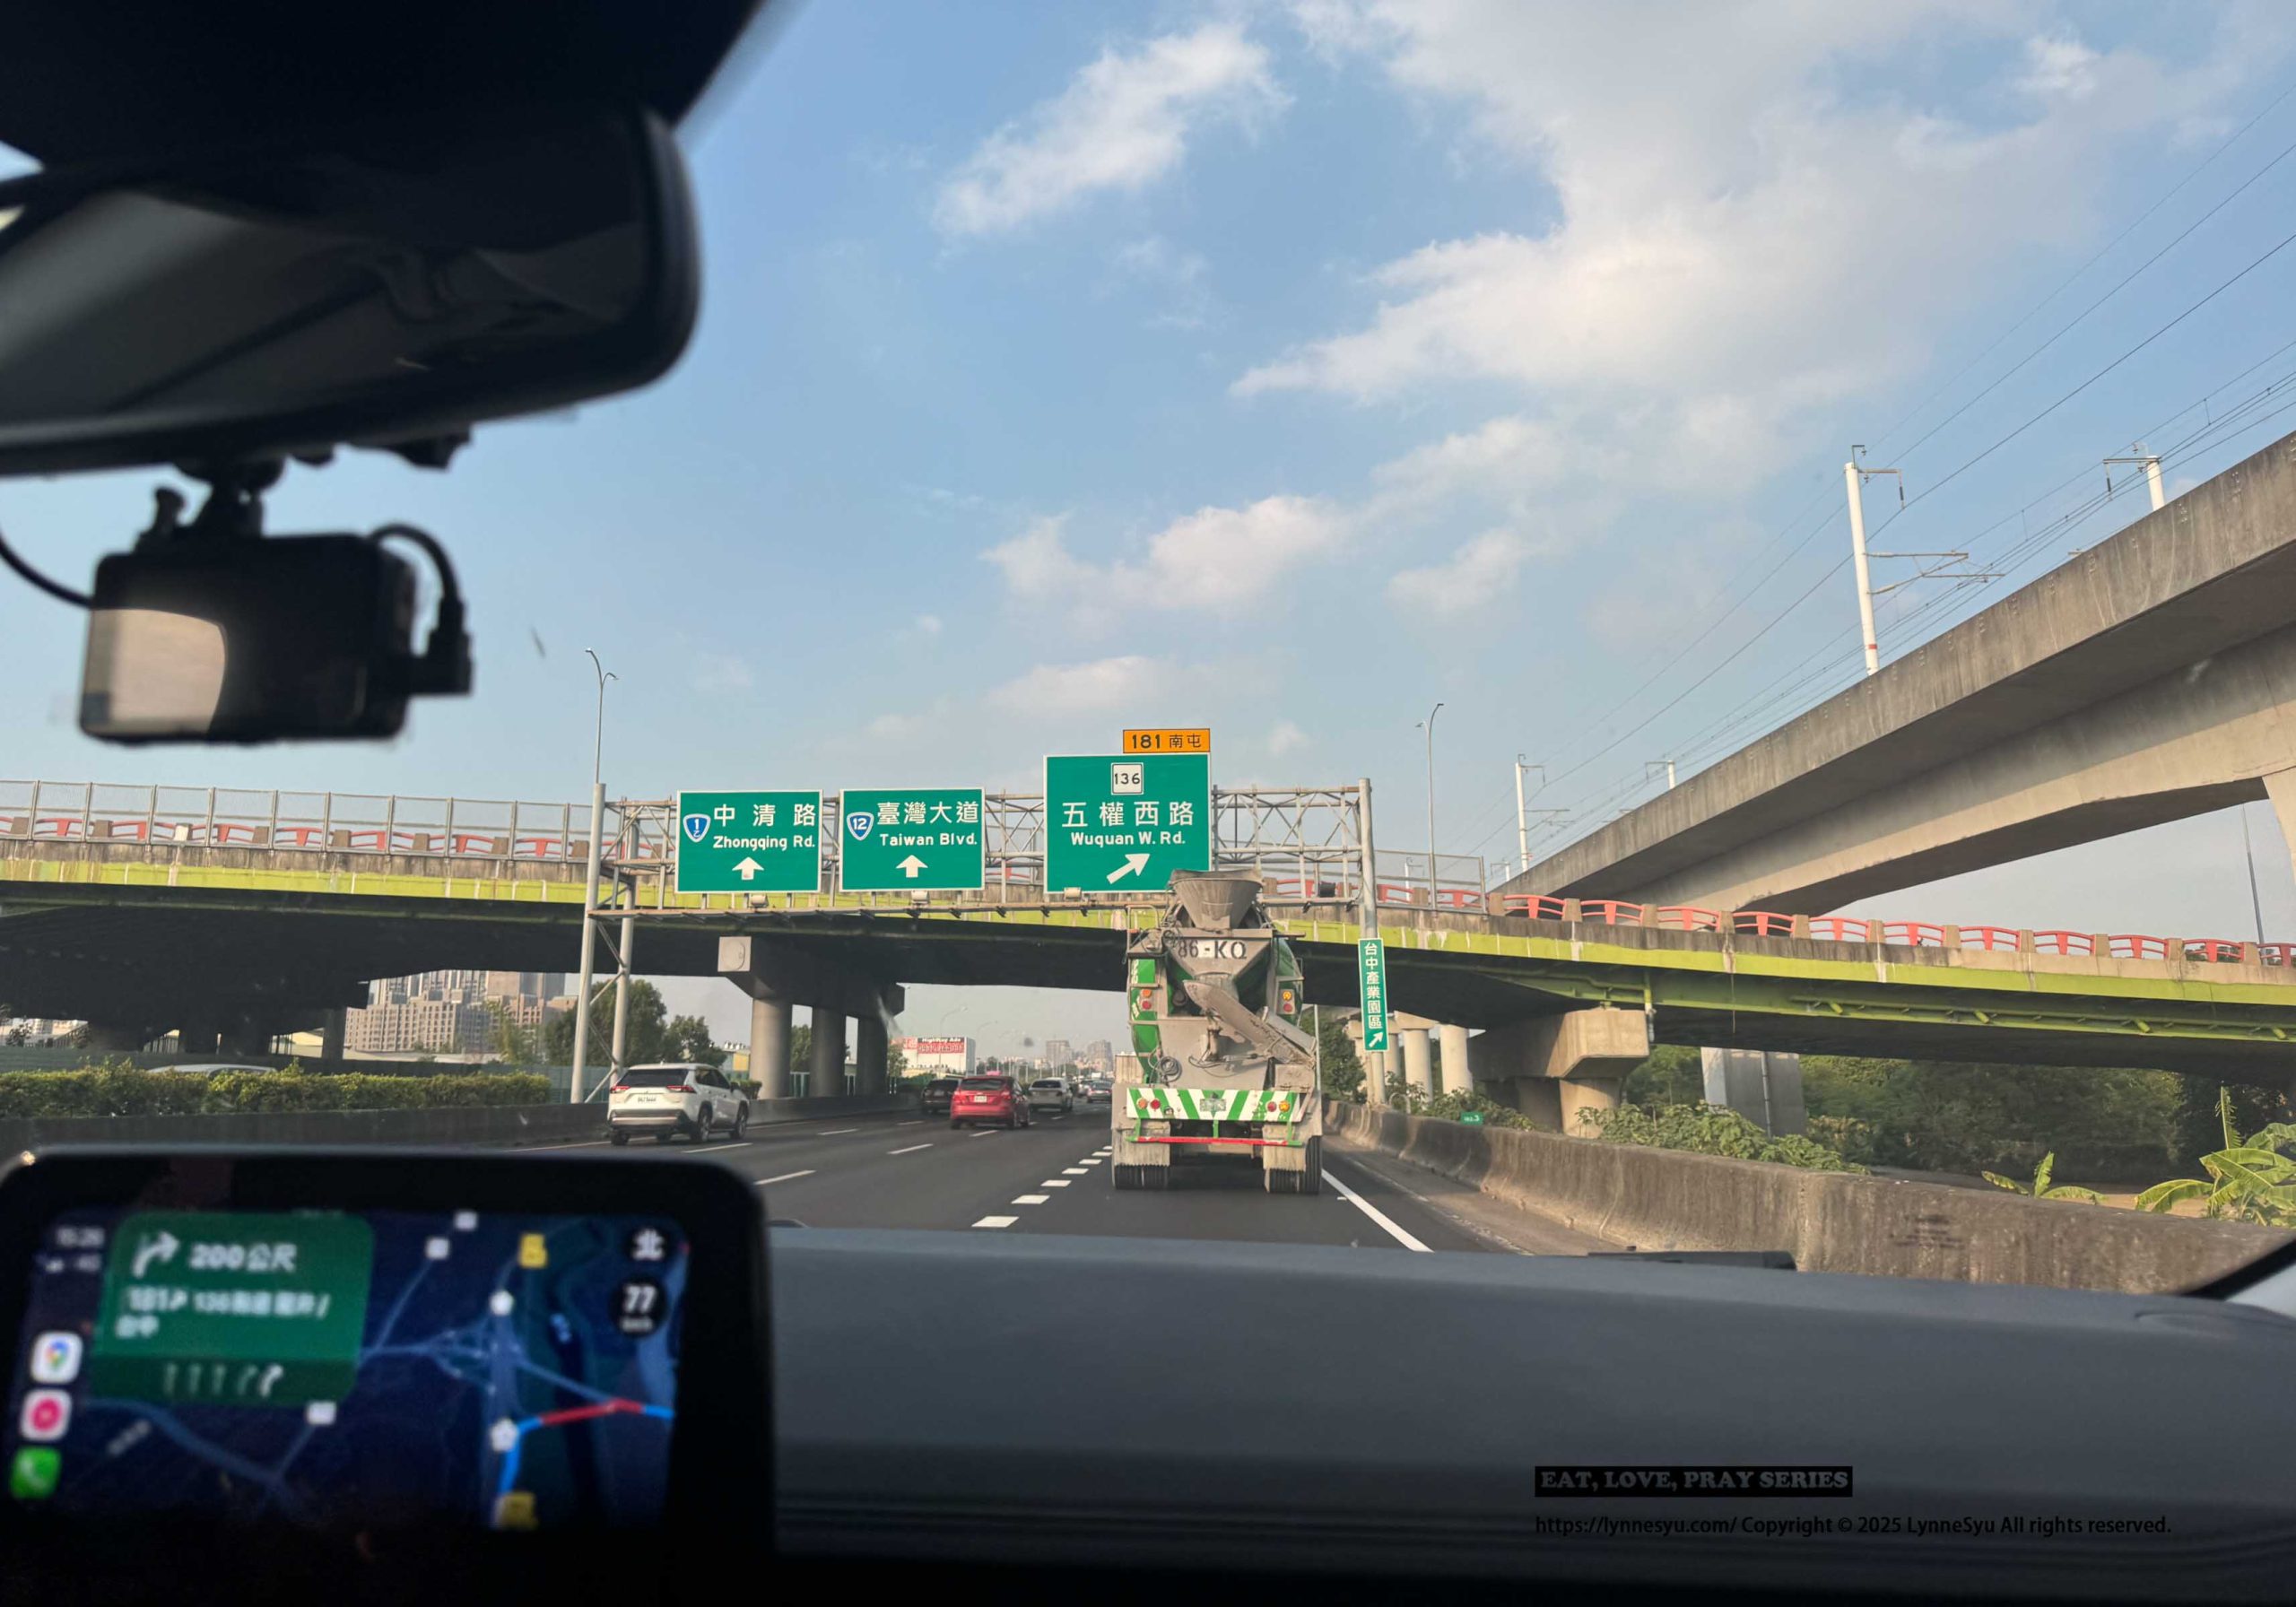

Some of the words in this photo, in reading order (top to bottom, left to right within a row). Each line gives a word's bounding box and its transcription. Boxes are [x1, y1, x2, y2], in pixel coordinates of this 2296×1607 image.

[1131, 734, 1161, 750] 181
[1169, 734, 1202, 749] 南屯
[1114, 772, 1141, 786] 136
[714, 804, 816, 827] 中清路
[877, 800, 979, 825] 臺灣大道
[1062, 800, 1195, 828] 五權西路
[694, 818, 700, 830] 1
[852, 817, 867, 830] 12
[713, 835, 787, 851] Zhongqing
[793, 835, 815, 847] Rd.
[880, 833, 935, 846] Taiwan
[939, 832, 978, 845] Blvd.
[1070, 831, 1135, 847] Wuquan
[1138, 831, 1156, 845] W.
[1160, 830, 1186, 845] Rd.
[623, 1283, 657, 1313] 77
